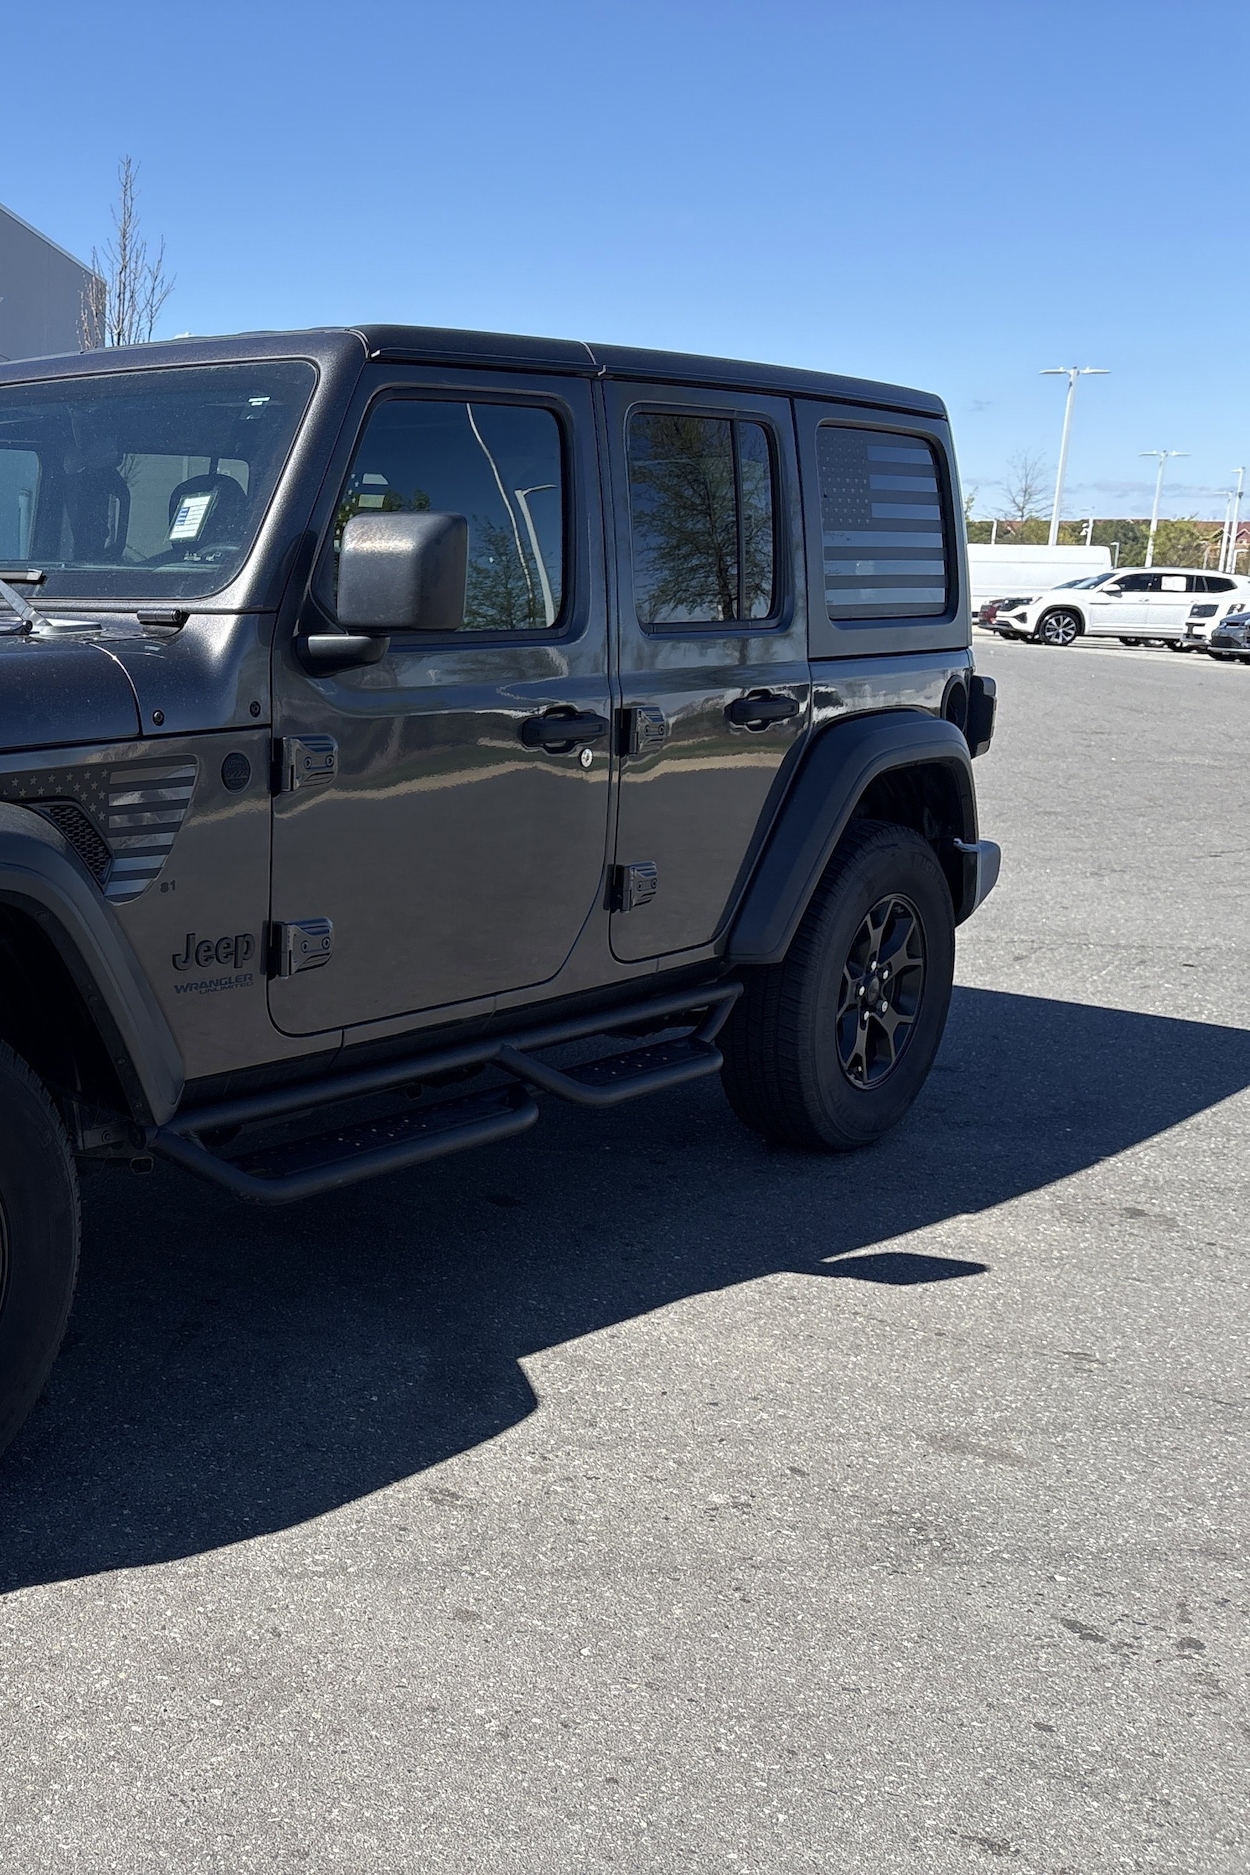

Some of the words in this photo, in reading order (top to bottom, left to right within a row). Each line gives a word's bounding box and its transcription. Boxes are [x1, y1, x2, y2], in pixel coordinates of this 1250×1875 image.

[172, 933, 256, 971] Jeep
[174, 973, 254, 994] WRANGLER
[199, 982, 254, 995] UNLIMITED
